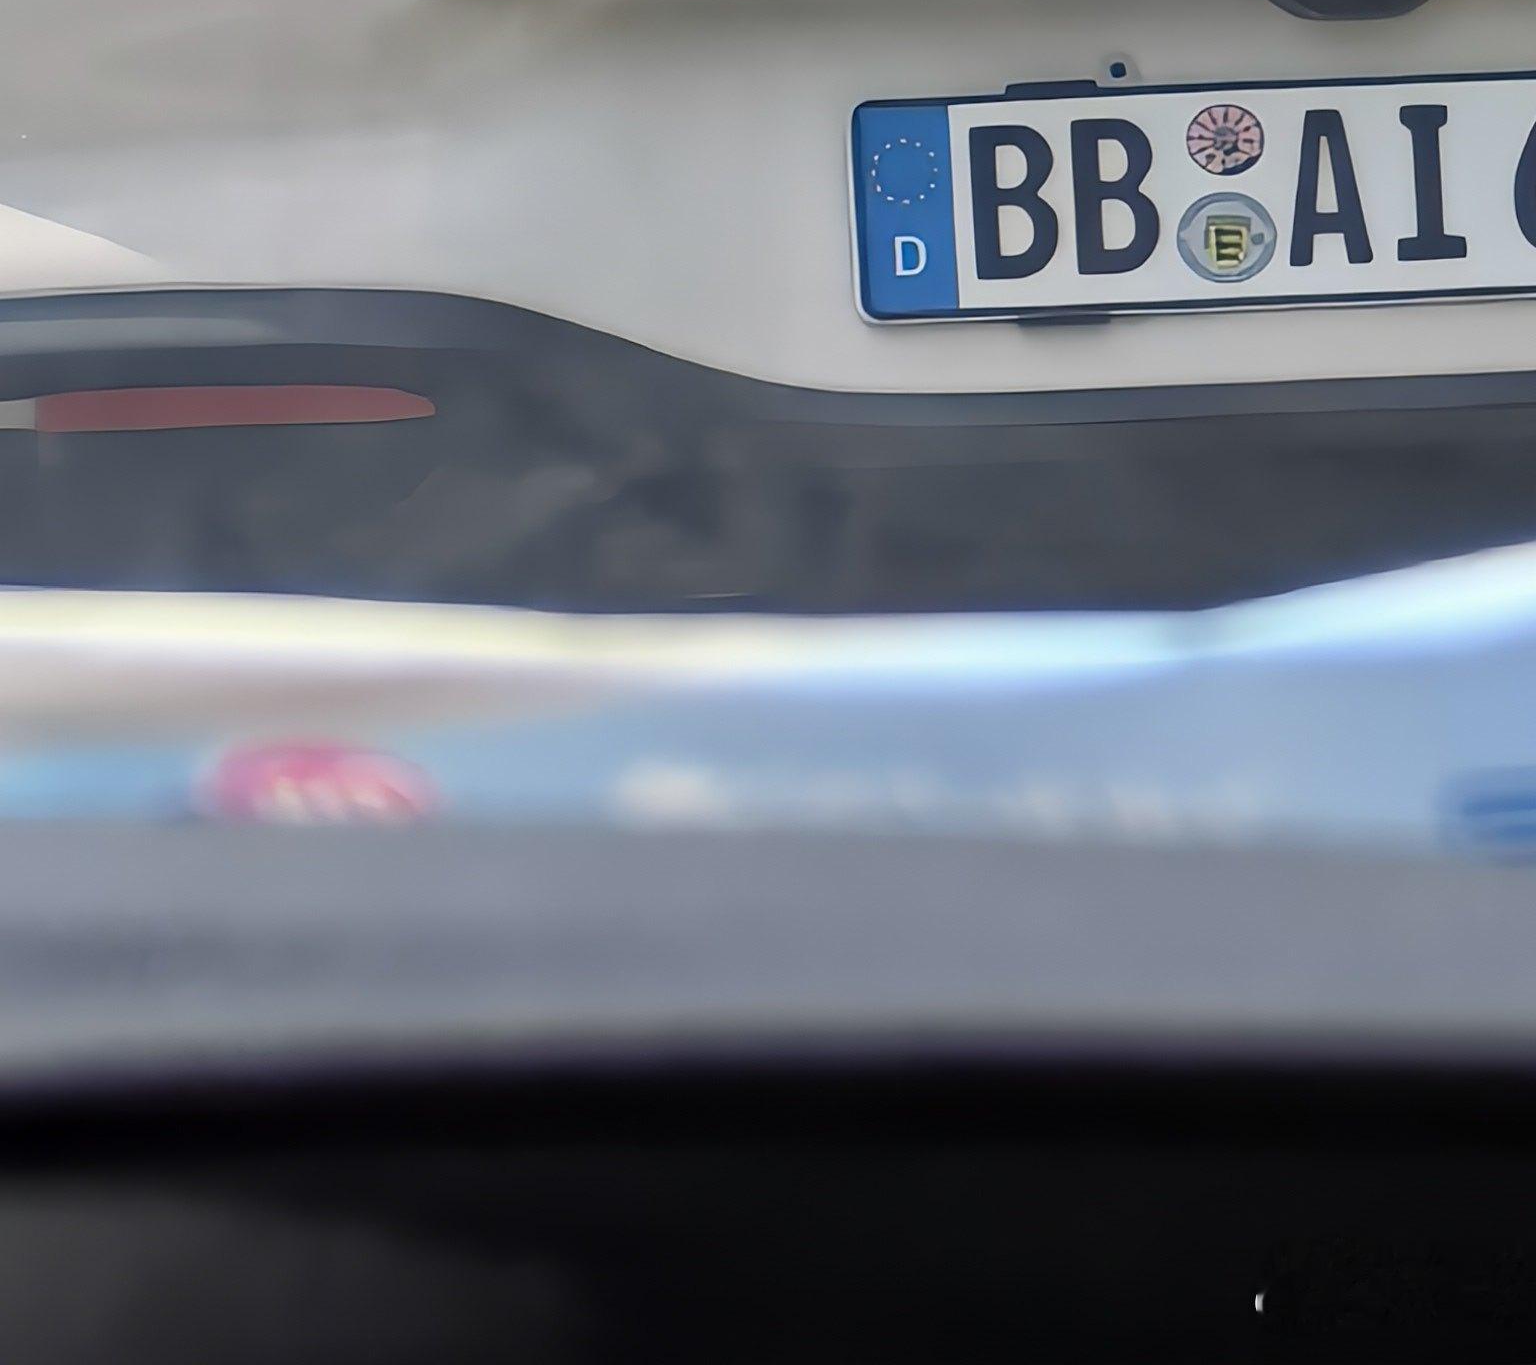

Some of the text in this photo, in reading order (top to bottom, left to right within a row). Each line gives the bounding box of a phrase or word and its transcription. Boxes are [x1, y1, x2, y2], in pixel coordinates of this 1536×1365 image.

[968, 118, 1161, 281] BB
[1289, 104, 1468, 267] AI
[894, 236, 927, 276] D
